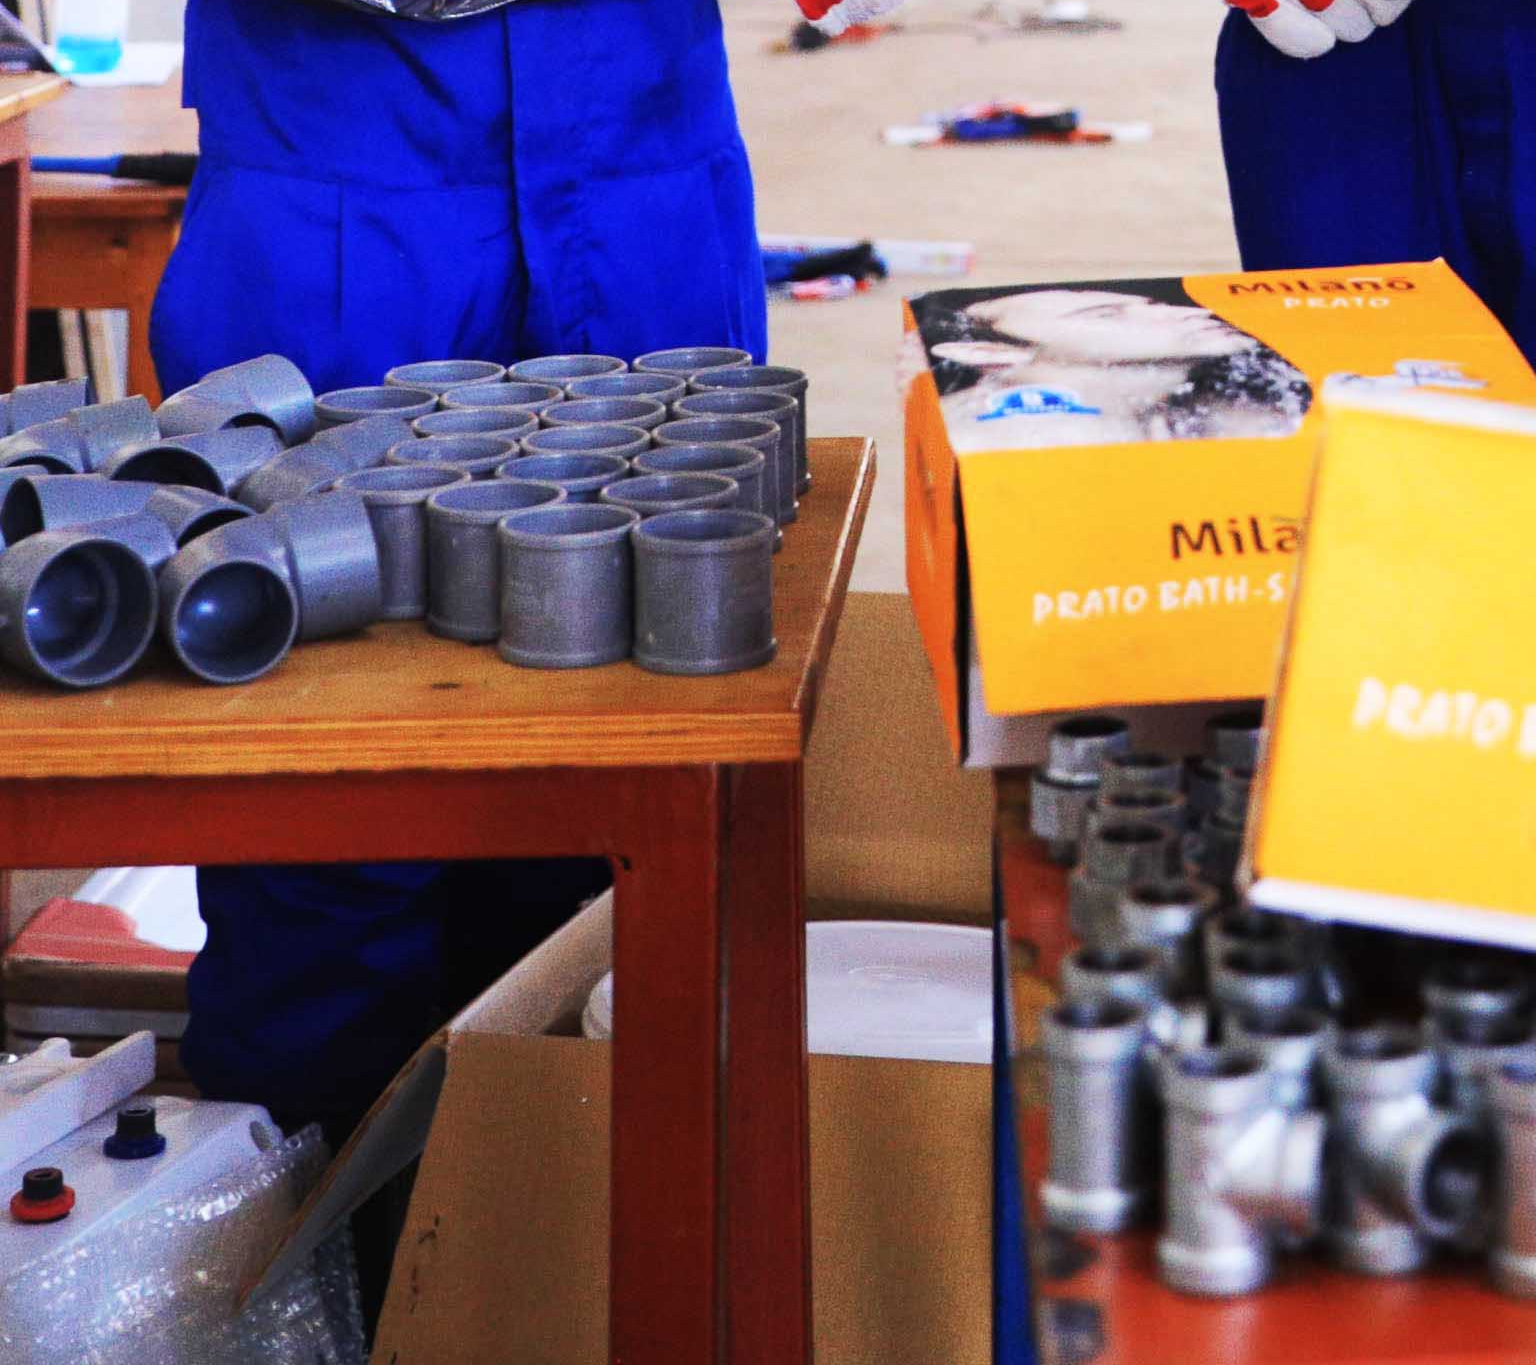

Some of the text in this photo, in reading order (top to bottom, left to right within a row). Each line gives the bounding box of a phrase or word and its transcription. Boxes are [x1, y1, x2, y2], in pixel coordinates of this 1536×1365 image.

[1228, 277, 1415, 295] Milano
[1284, 296, 1391, 309] PRATO
[1170, 515, 1302, 560] Mila
[1033, 571, 1296, 624] PRATO BATH-S
[1353, 676, 1513, 749] PRATO
